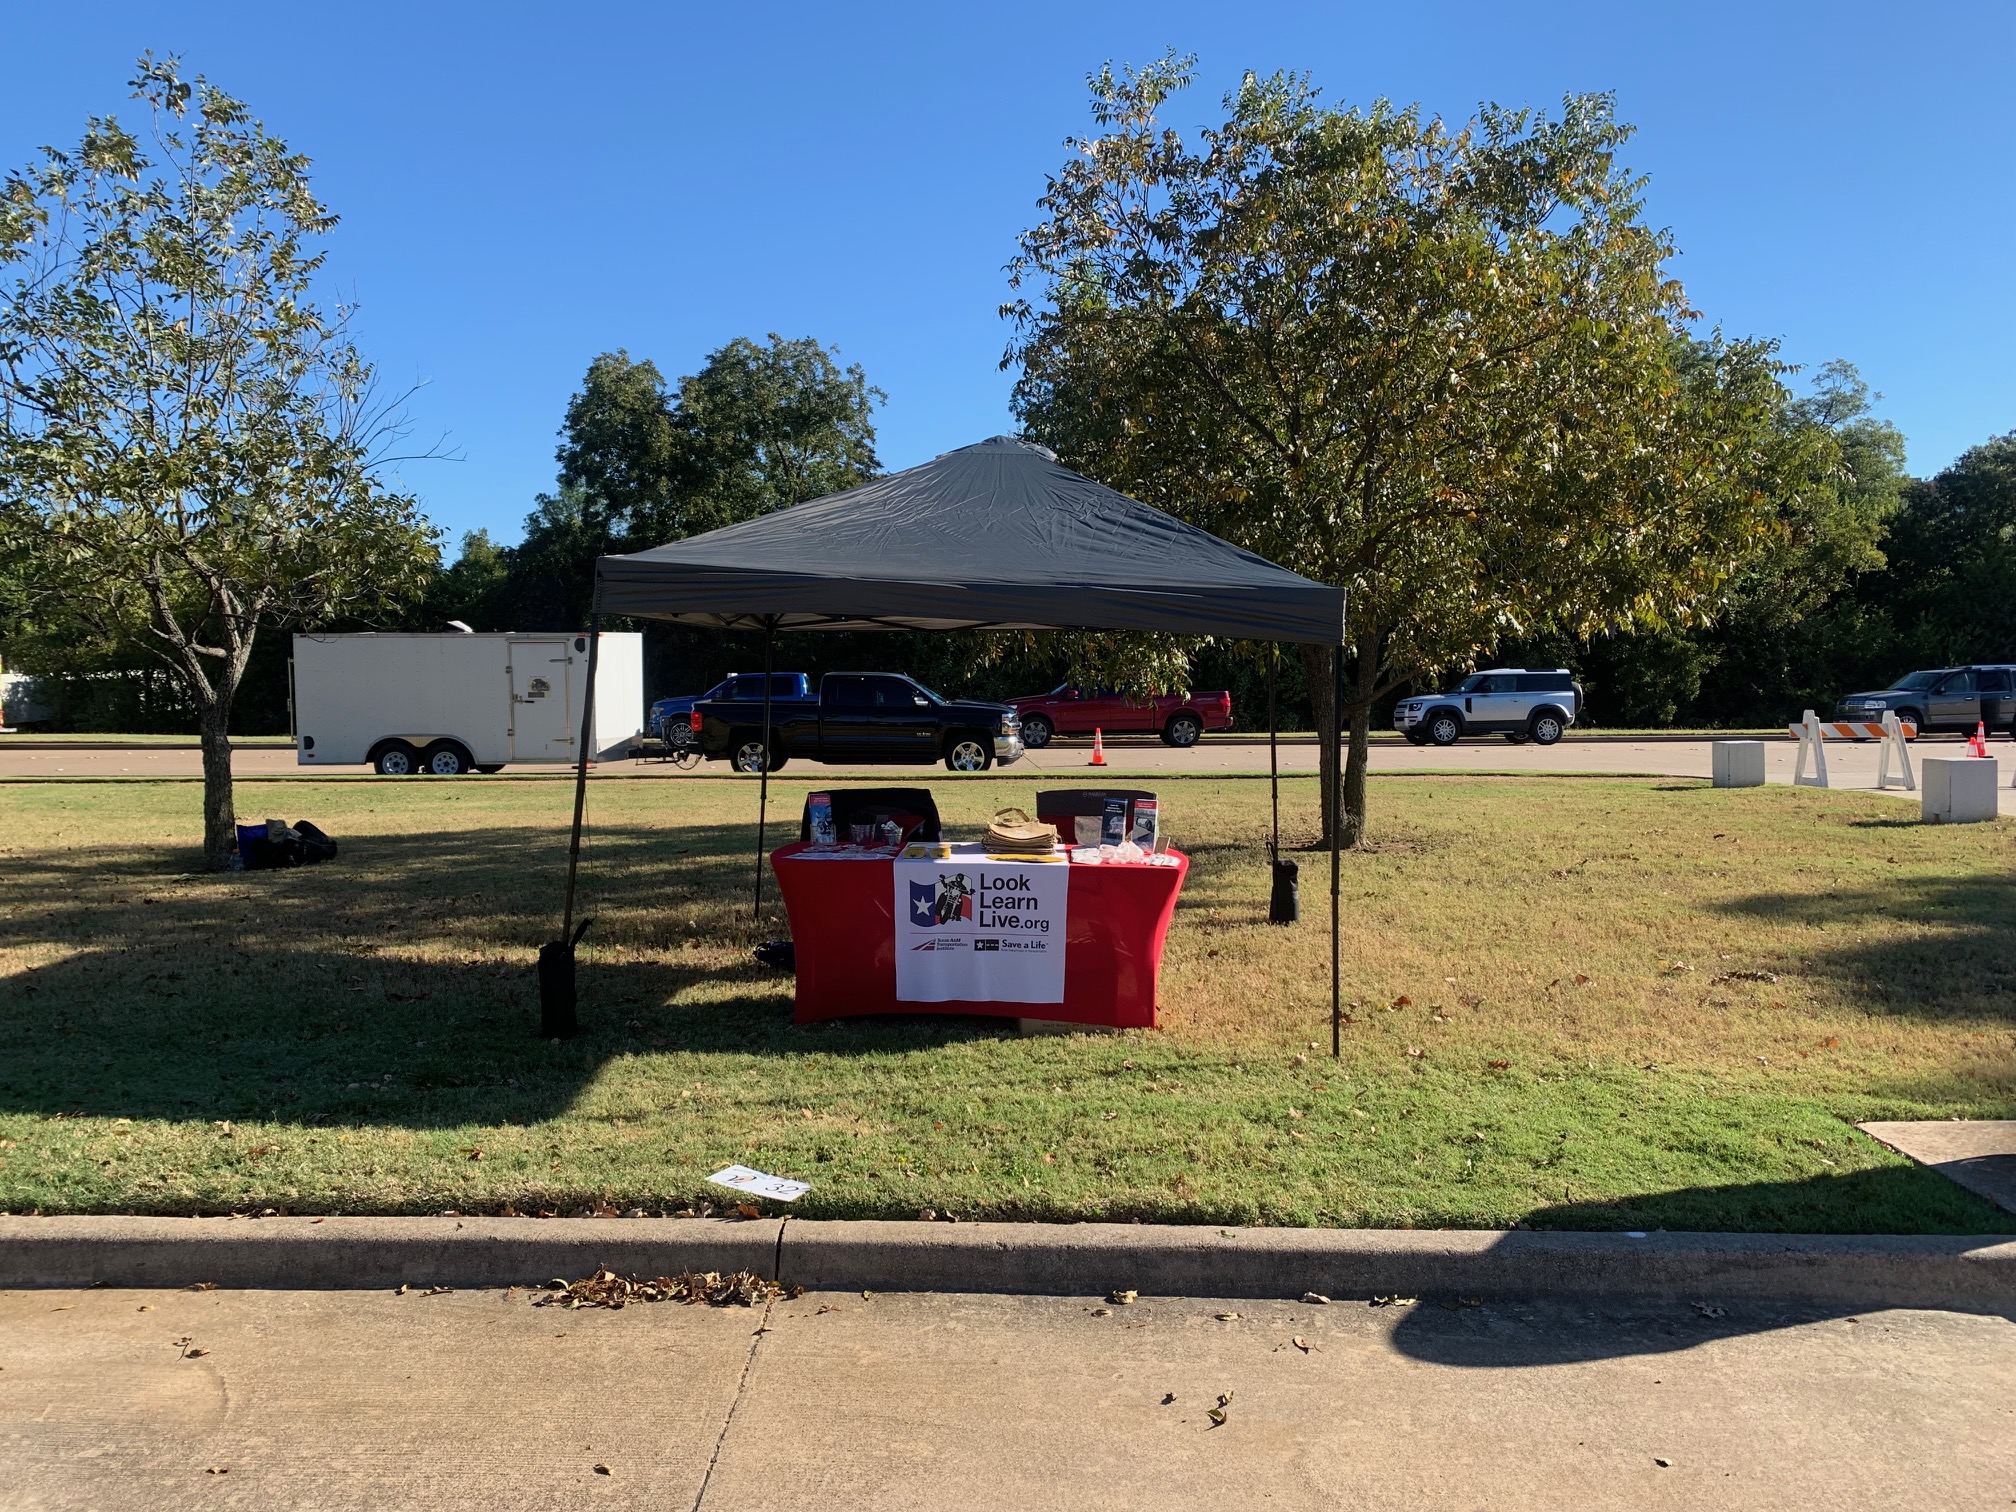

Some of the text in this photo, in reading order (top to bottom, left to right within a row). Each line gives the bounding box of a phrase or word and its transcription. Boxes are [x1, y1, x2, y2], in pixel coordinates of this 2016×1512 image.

[980, 873, 1031, 891] Look
[980, 892, 1038, 910] Learn
[979, 911, 1050, 932] Live.org
[1002, 939, 1022, 948] Save
